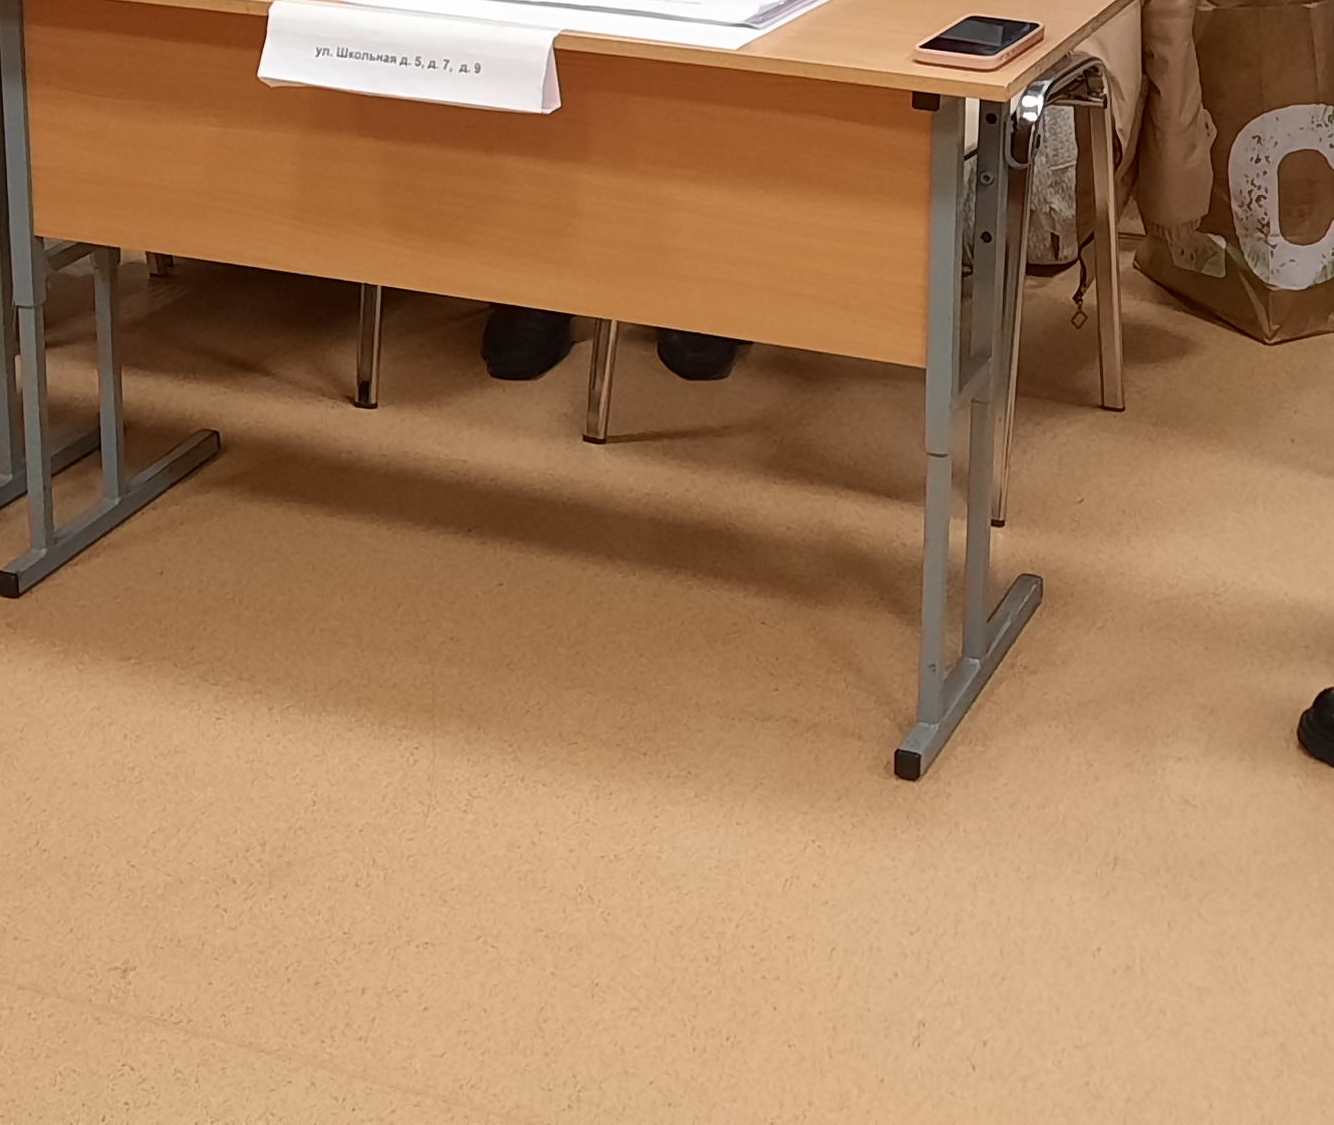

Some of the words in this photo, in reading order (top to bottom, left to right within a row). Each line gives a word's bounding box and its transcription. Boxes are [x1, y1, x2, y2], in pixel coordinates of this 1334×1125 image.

[315, 46, 333, 58] ул.
[336, 46, 397, 64] Школьная
[399, 56, 411, 66] д.
[414, 56, 425, 68] 5,
[442, 59, 453, 73] 7,
[458, 63, 470, 73] д.
[473, 62, 482, 74] 9
